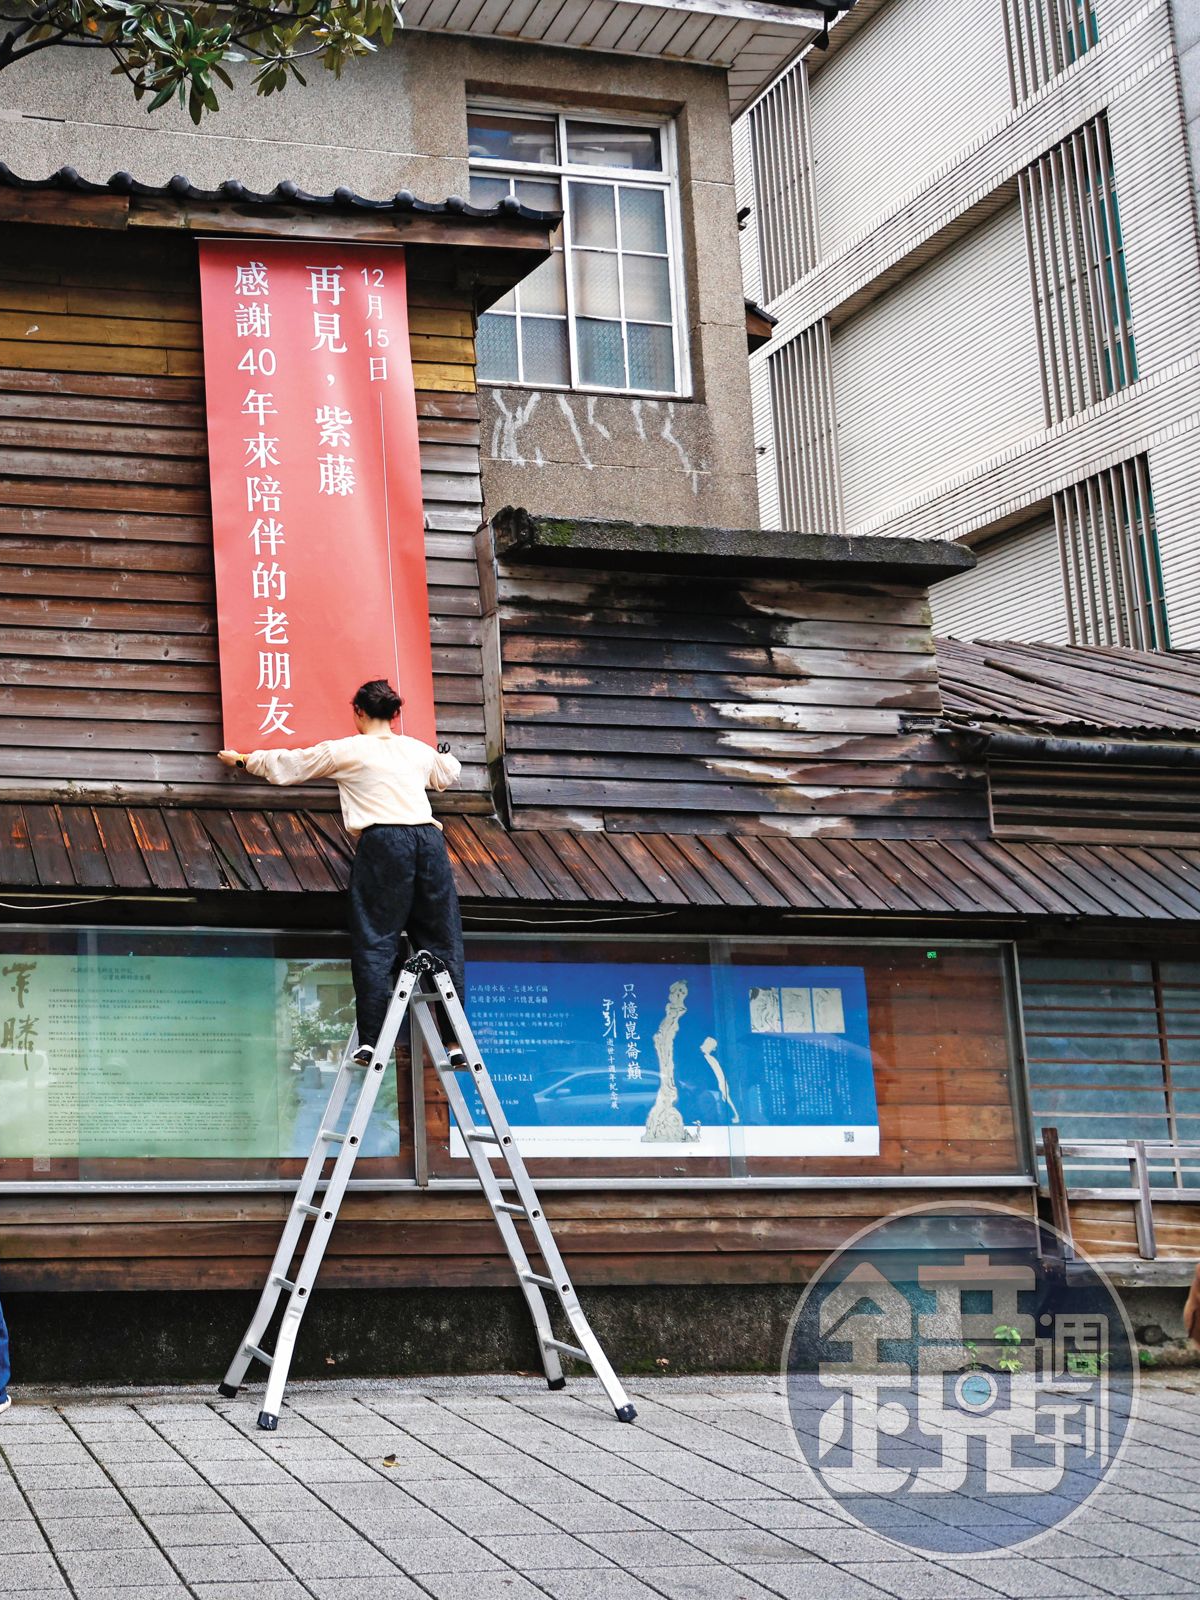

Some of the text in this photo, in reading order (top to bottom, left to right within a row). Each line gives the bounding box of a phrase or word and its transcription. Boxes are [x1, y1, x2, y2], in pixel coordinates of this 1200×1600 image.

[305, 264, 356, 497] 再見，紫藤
[360, 267, 390, 382] 12月15日
[234, 261, 296, 737] 感謝40年來陪伴的老朋友
[621, 983, 643, 1081] 只憶崑崙巔
